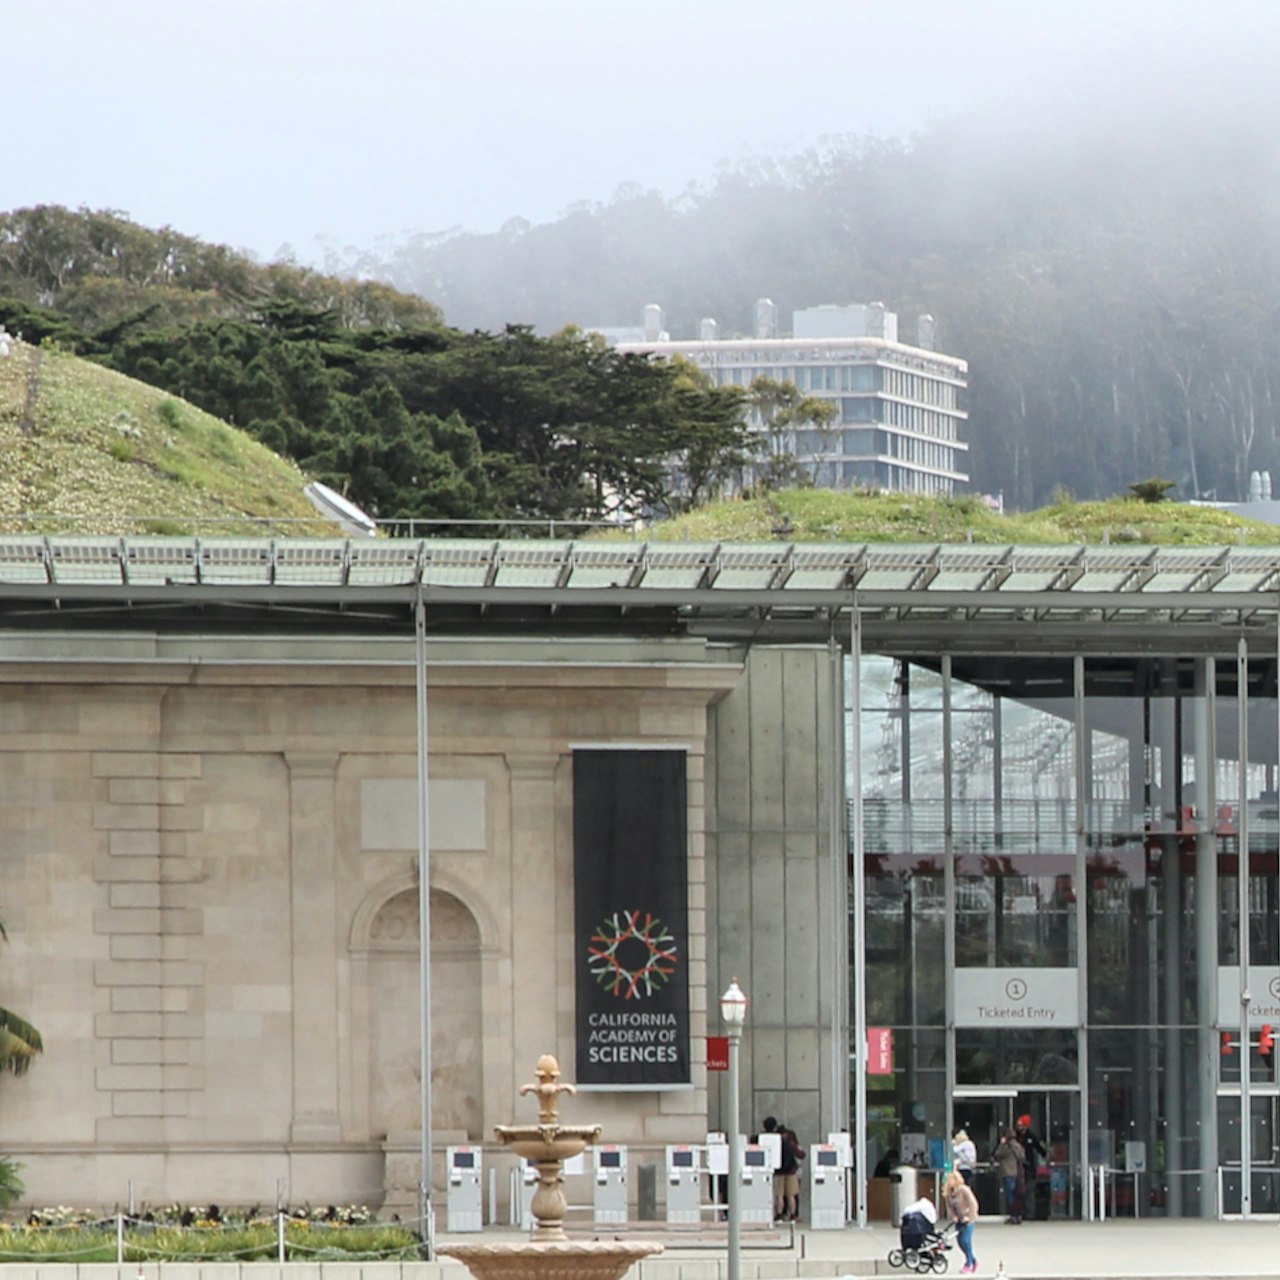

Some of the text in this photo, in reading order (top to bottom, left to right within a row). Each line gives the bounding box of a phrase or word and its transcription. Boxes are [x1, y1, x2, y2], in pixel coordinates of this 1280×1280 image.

[588, 1013, 677, 1026] CALIFORNIA
[977, 1007, 1055, 1021] Ticketed Entry
[588, 1030, 677, 1043] ACADEMY OF
[588, 1047, 678, 1063] SCIENCES
